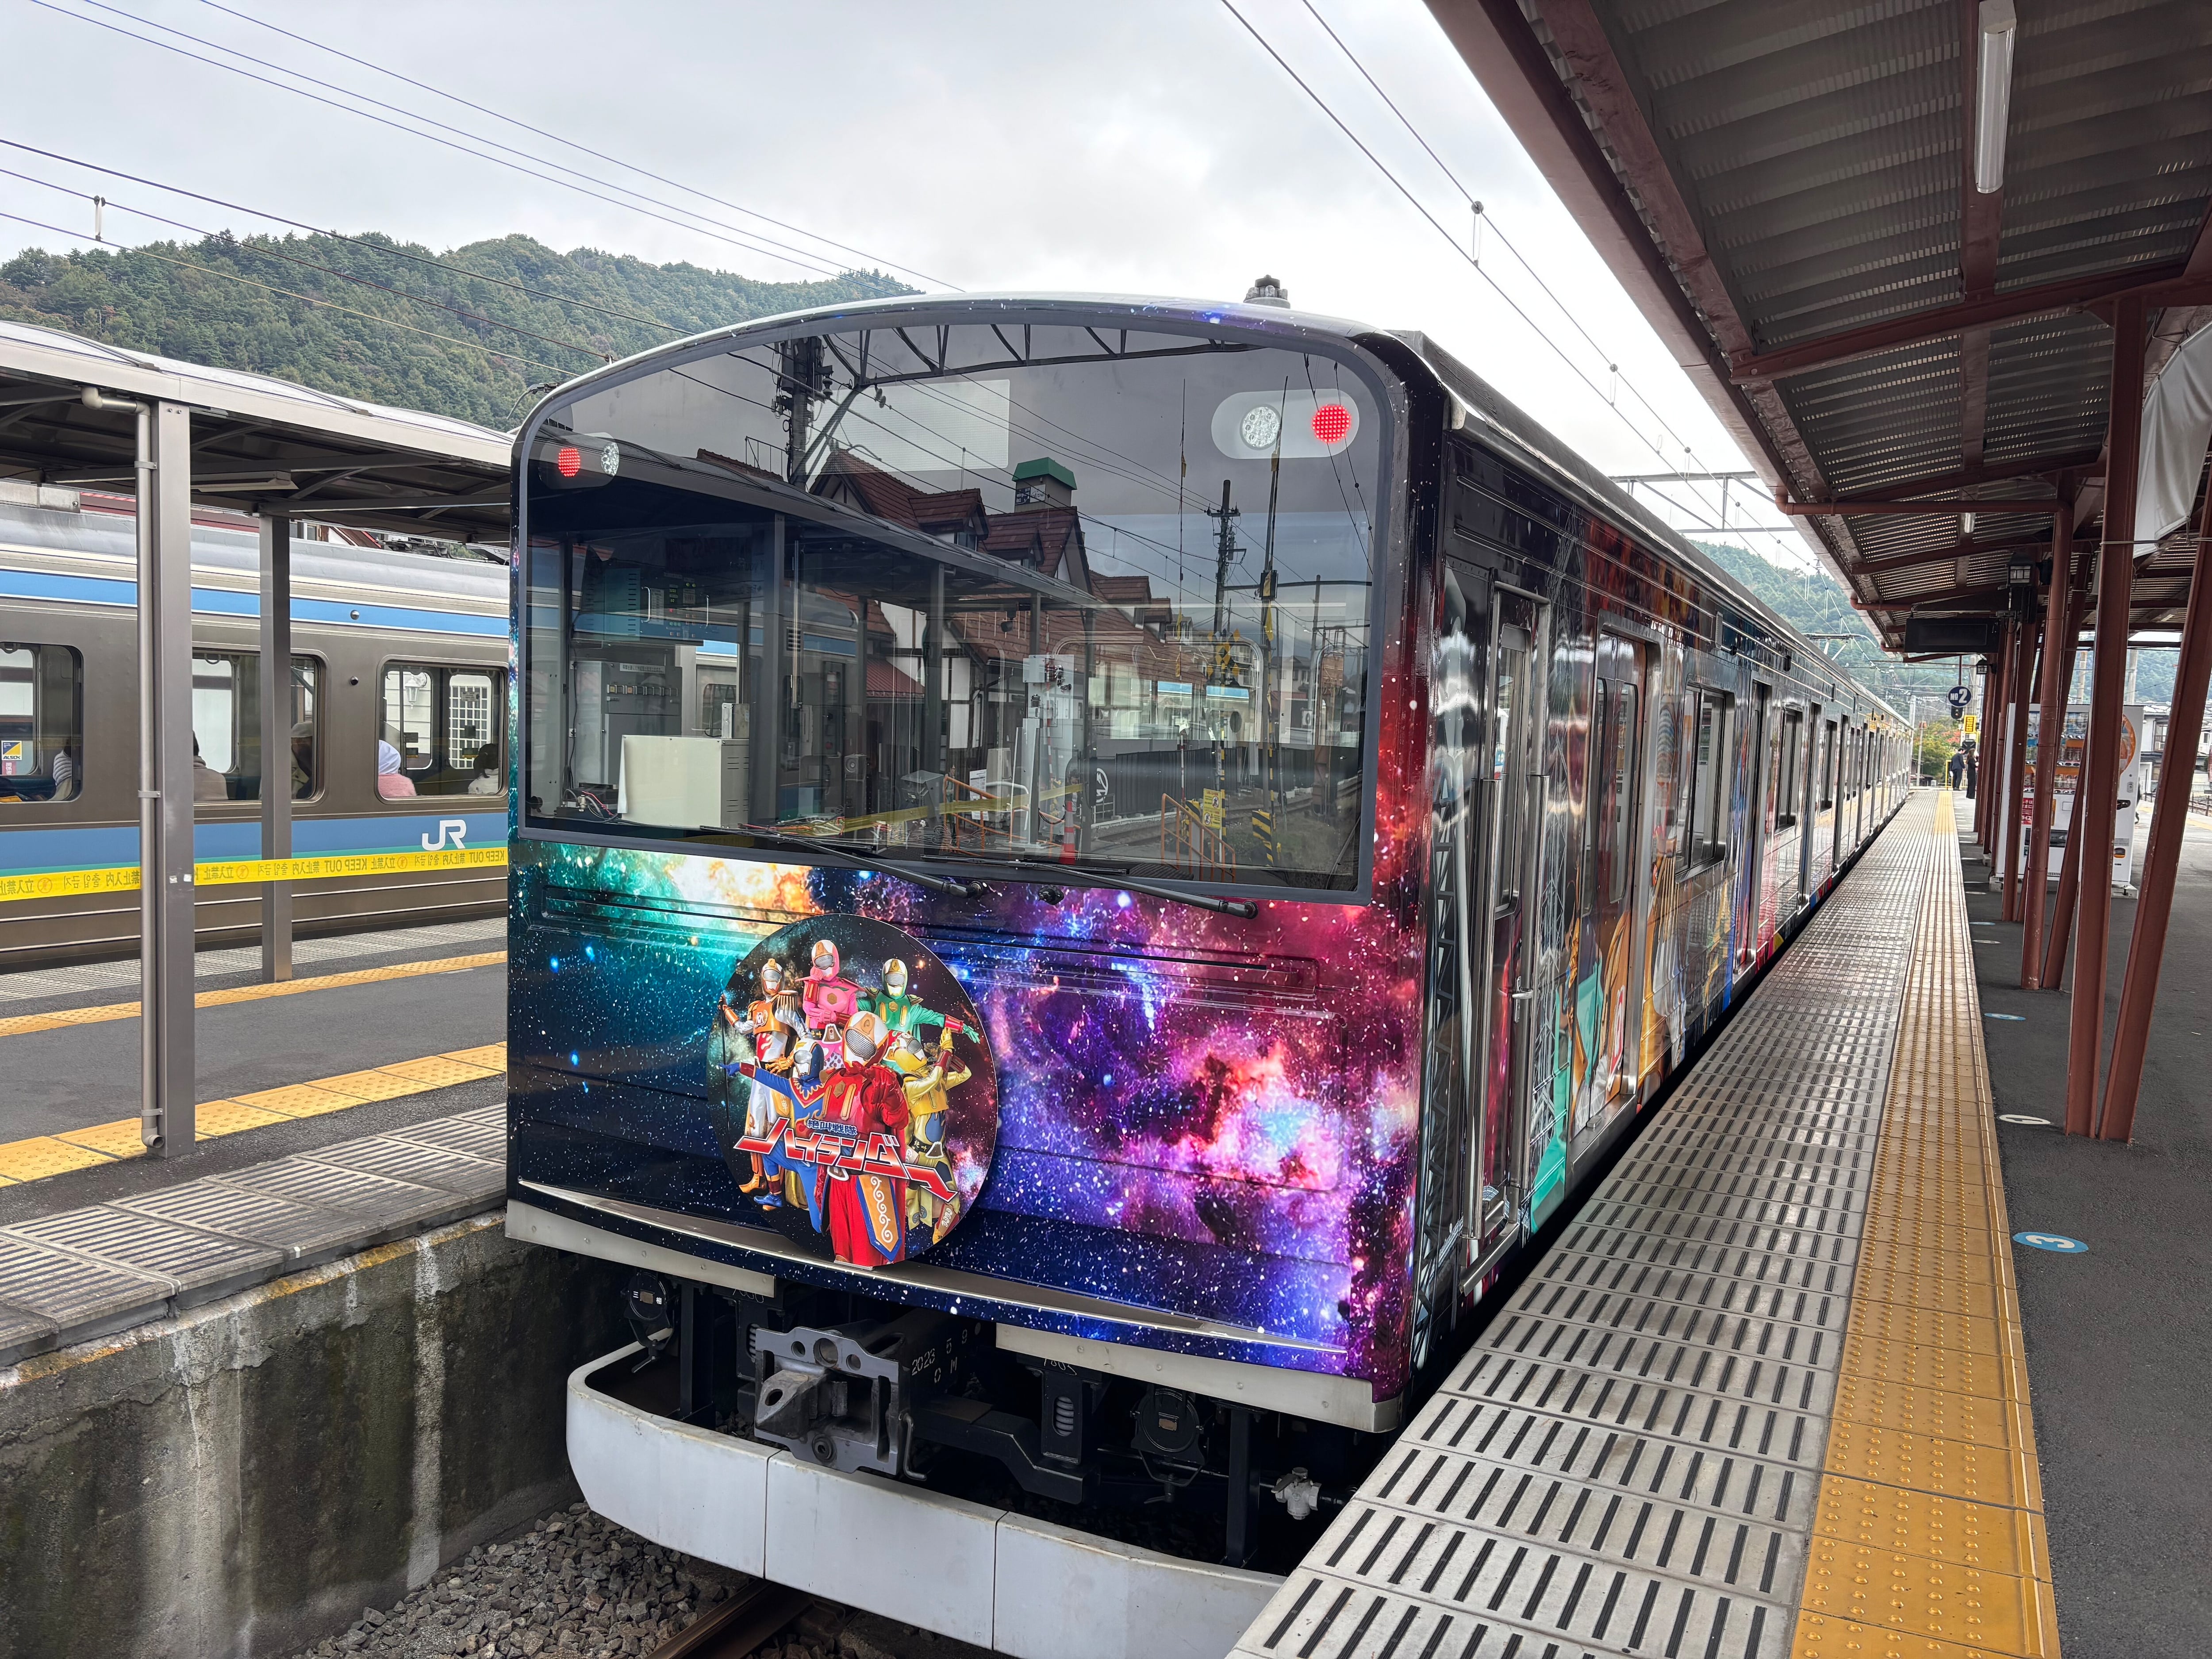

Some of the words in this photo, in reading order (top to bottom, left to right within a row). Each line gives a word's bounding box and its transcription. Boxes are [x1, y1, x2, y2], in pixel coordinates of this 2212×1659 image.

[1959, 688, 1968, 703] 2
[421, 819, 467, 851] JR
[806, 1118, 858, 1136] 絶叫戦隊
[733, 1117, 958, 1202] ハイランダー
[2025, 1235, 2075, 1248] 3
[911, 1348, 935, 1376] 2023
[946, 1337, 952, 1354] 5
[961, 1328, 968, 1344] 9
[950, 1356, 958, 1374] M
